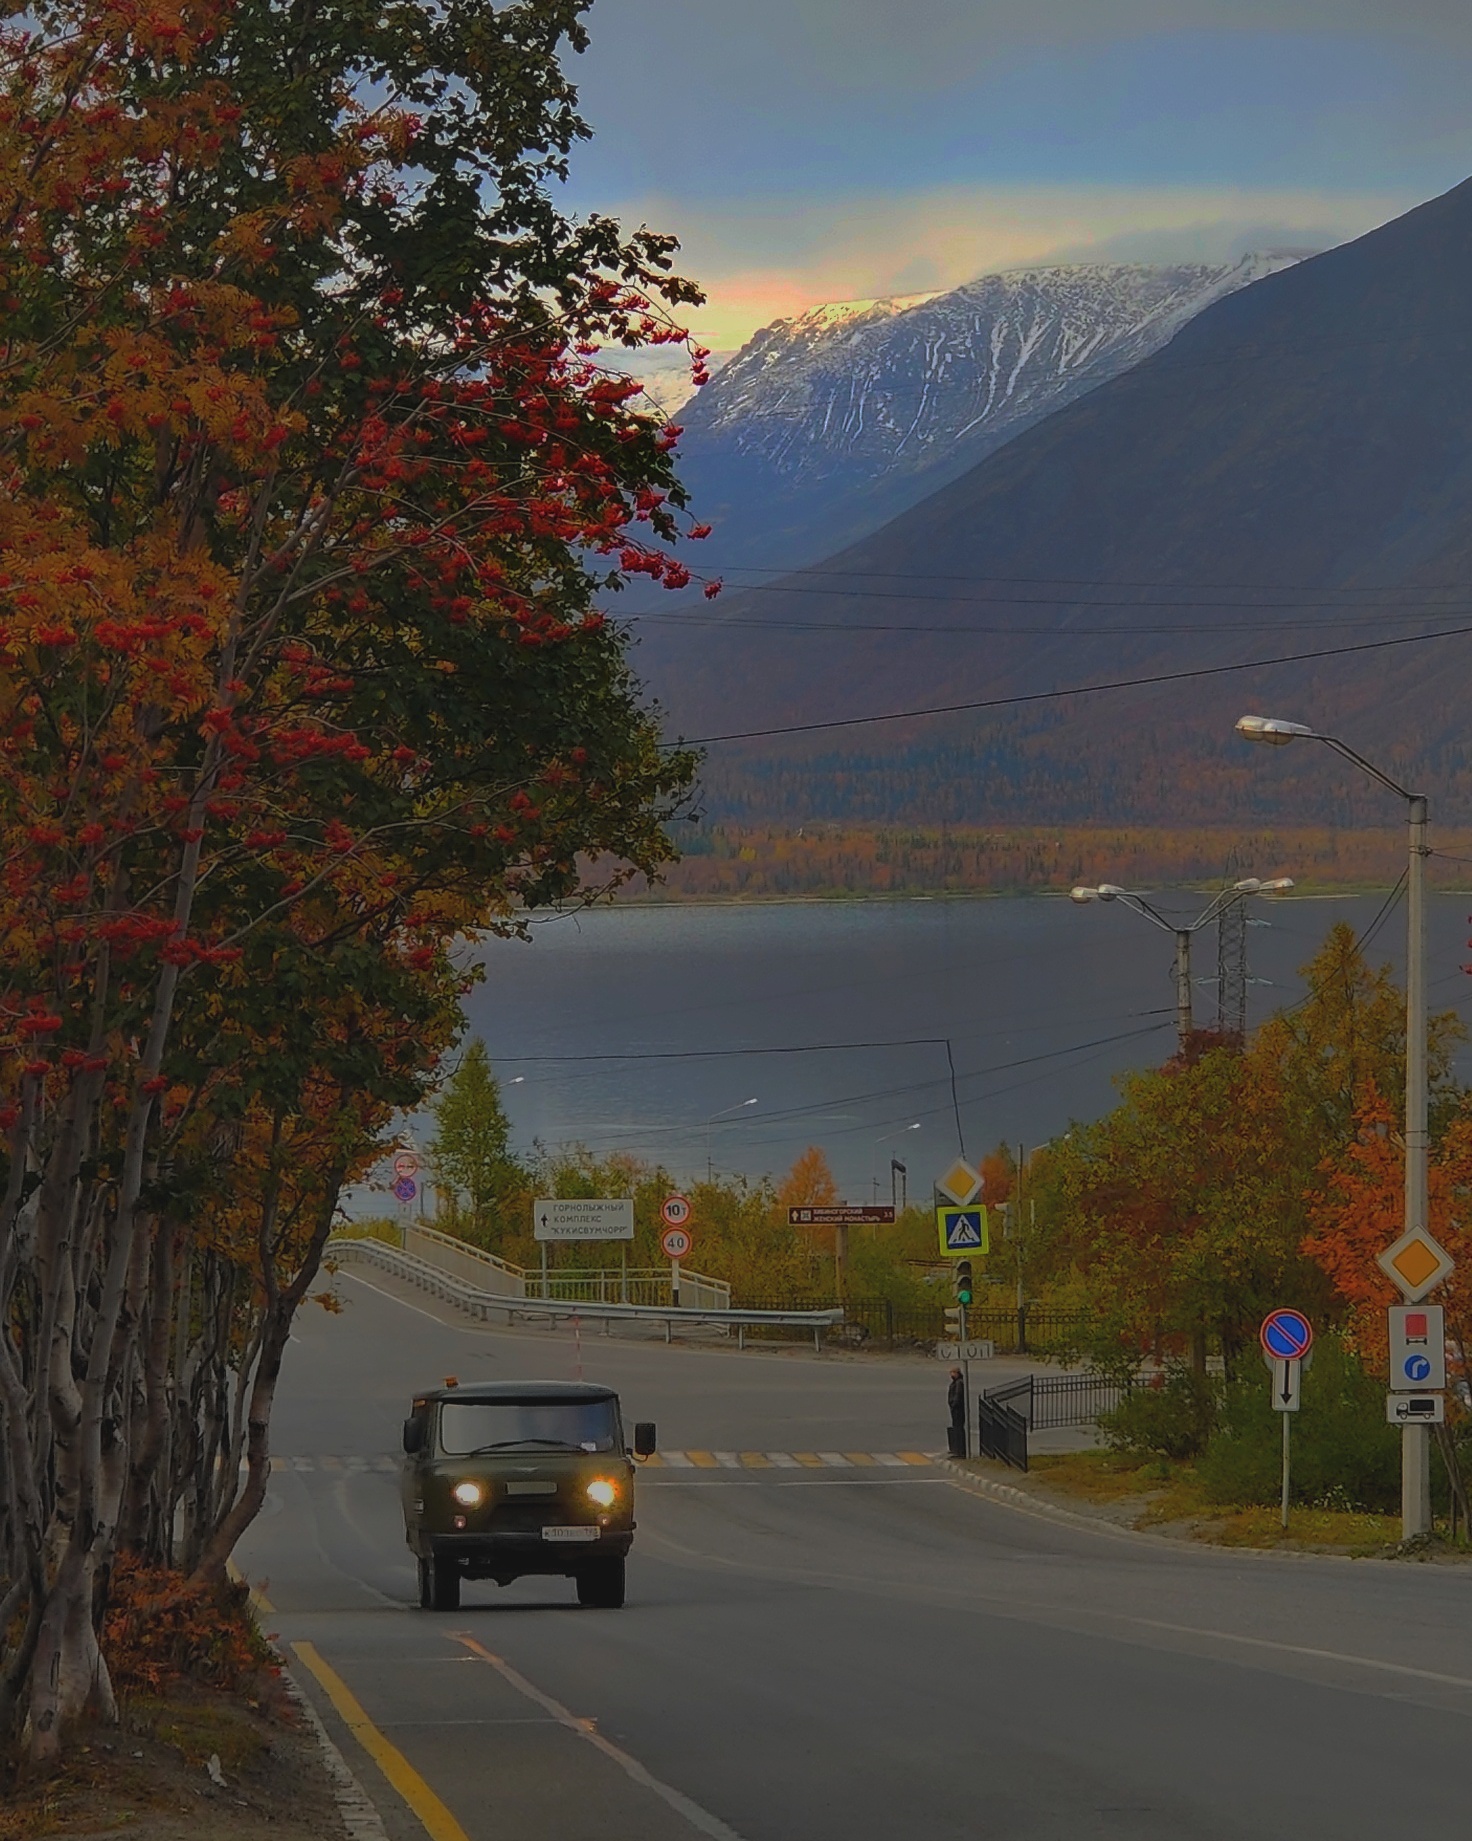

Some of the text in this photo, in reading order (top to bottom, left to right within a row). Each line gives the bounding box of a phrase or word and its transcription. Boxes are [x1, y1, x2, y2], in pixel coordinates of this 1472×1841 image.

[553, 1202, 625, 1212] ГОРНОЛЫЖНЫЙ
[554, 1215, 602, 1223] КОМПЛЕКС
[668, 1237, 684, 1248] 40
